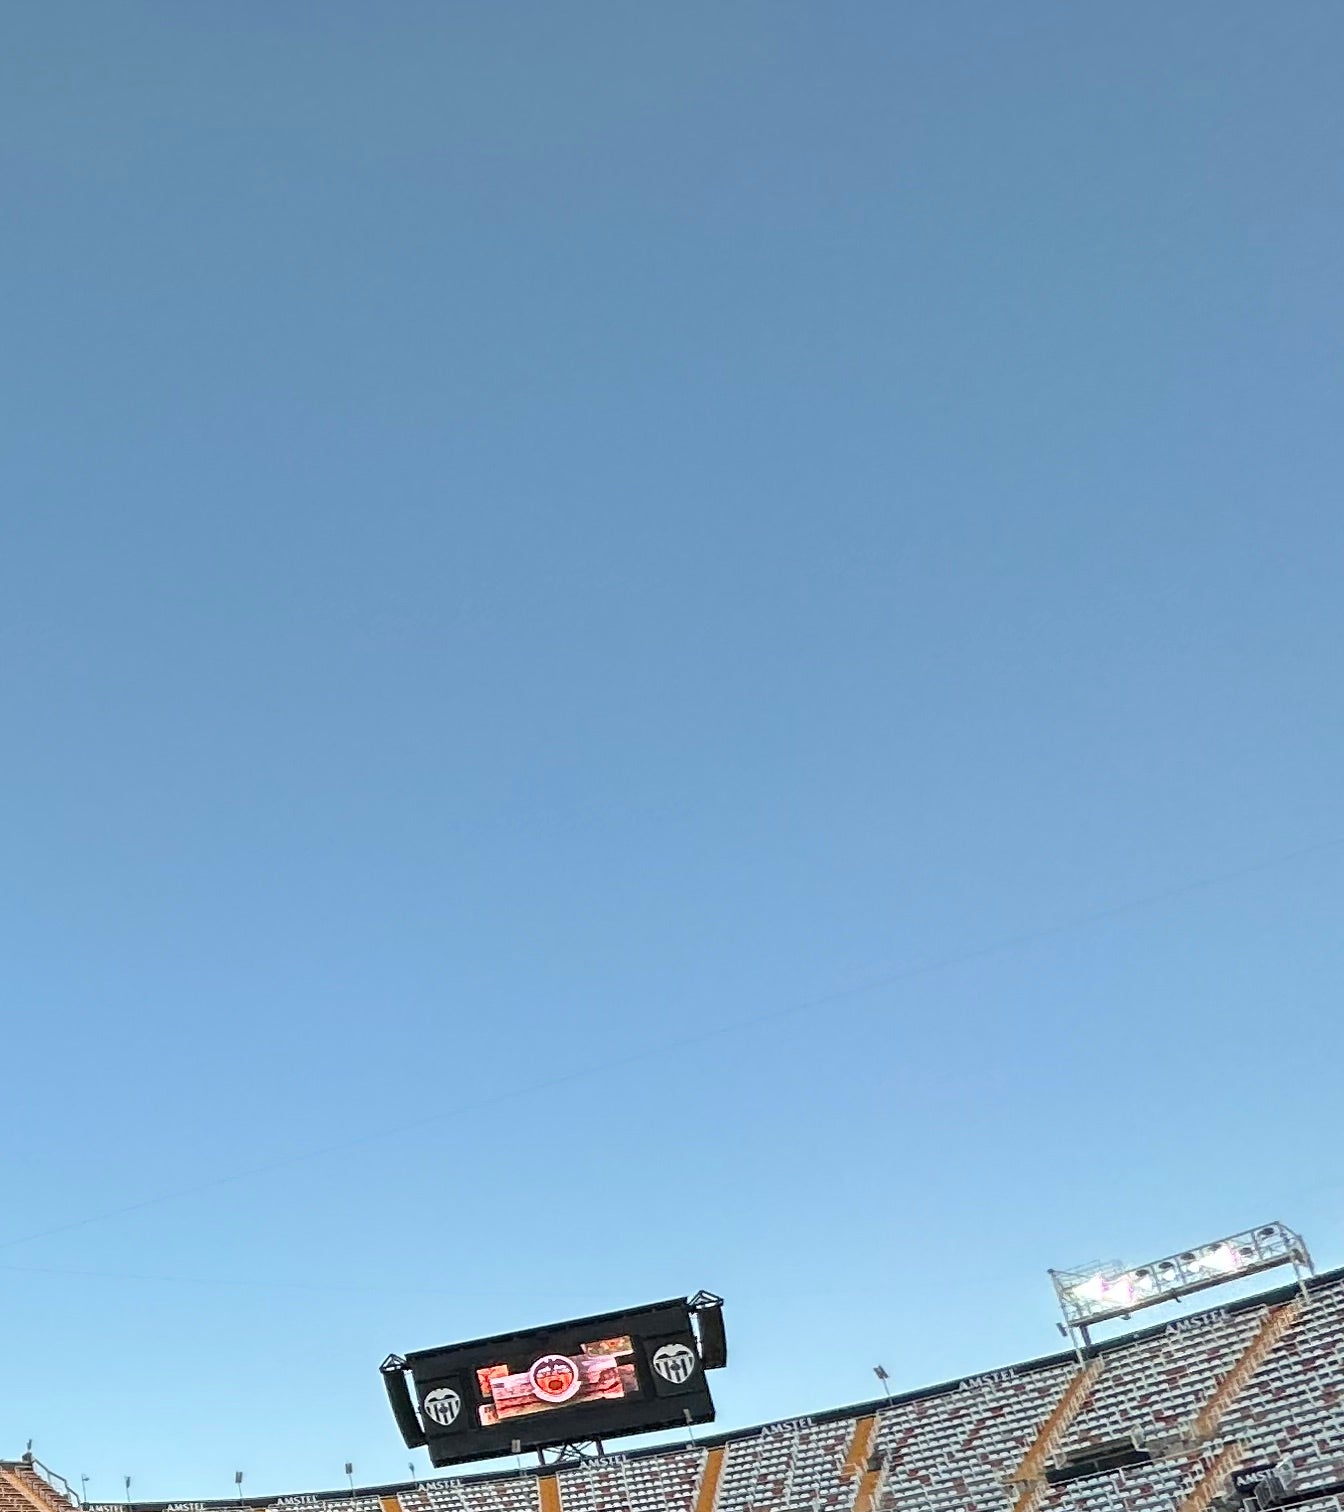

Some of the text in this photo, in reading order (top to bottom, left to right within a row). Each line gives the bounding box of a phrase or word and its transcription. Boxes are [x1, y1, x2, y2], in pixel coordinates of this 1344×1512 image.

[959, 1368, 1018, 1391] AMSTEL
[762, 1417, 816, 1436] AMSTEL
[418, 1479, 462, 1491] AMSTEL
[277, 1495, 318, 1506] AMSTEL
